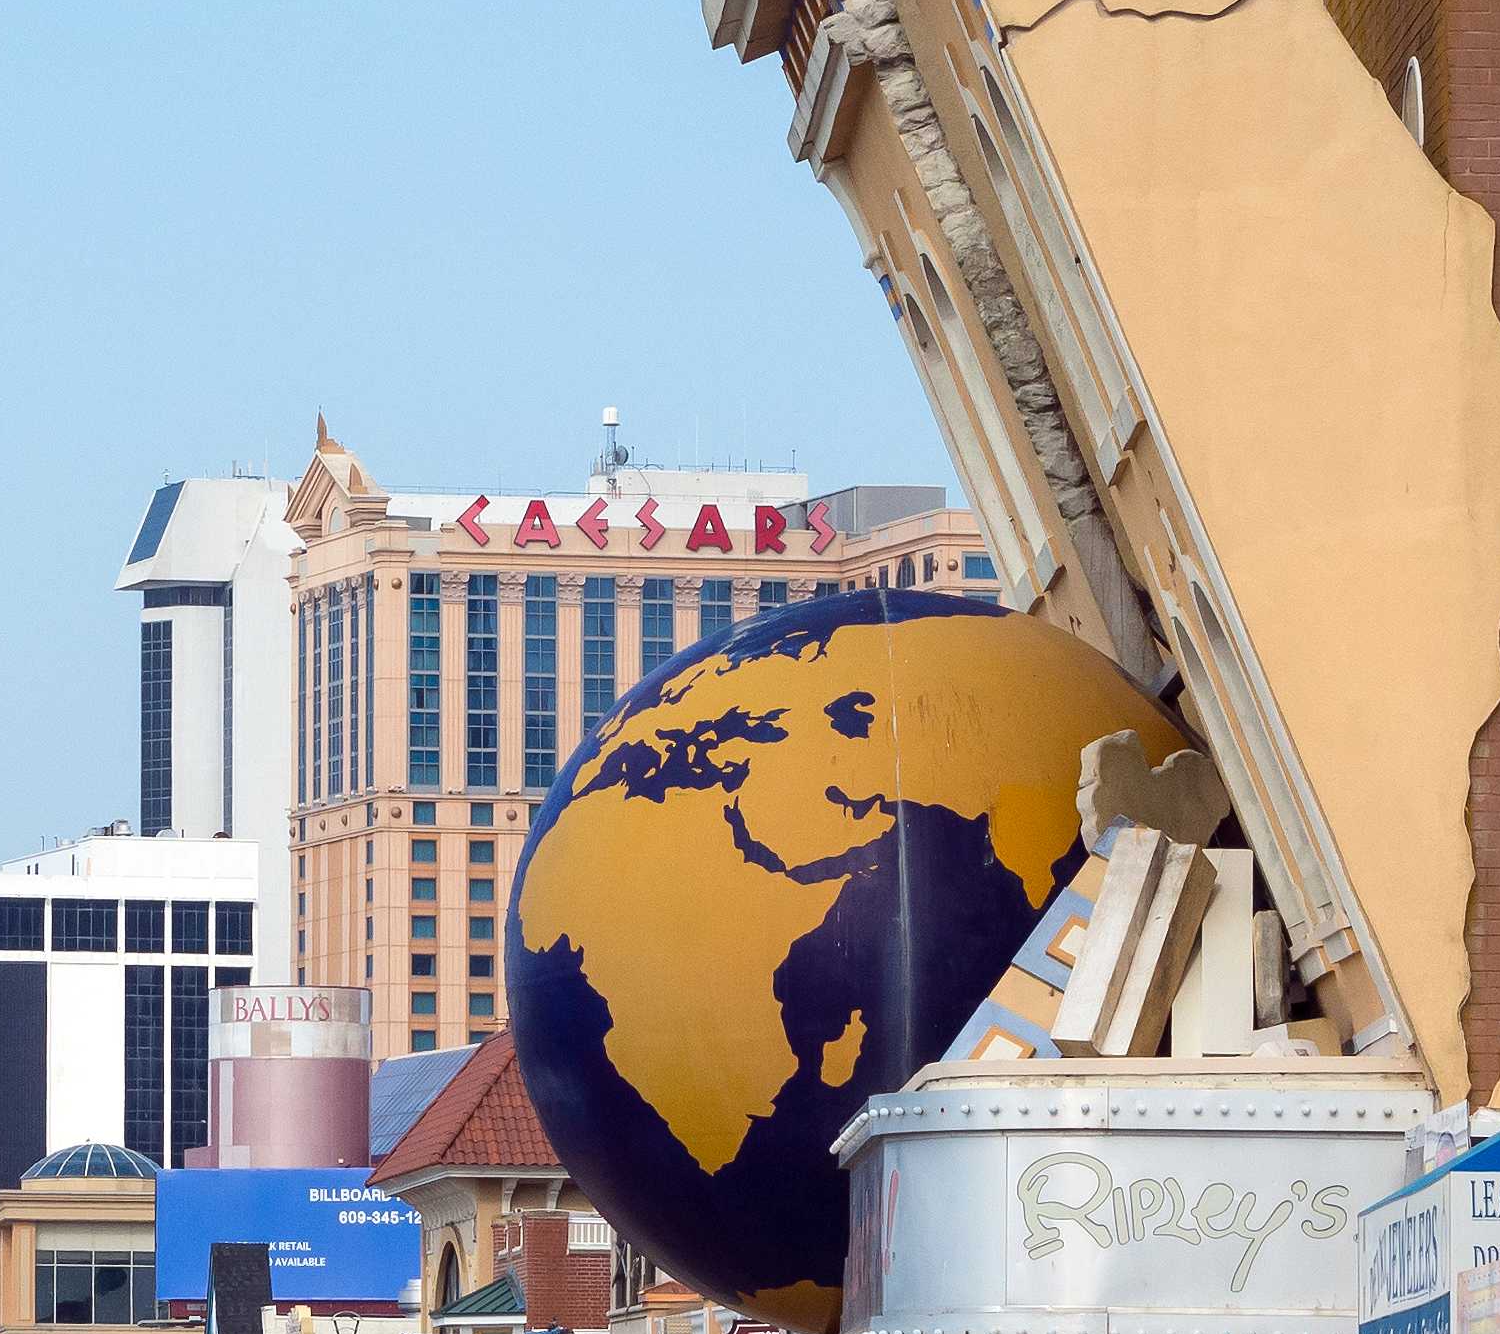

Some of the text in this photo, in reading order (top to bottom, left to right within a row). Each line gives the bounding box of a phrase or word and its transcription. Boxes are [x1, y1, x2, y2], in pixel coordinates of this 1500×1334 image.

[455, 494, 837, 556] CAESARS
[234, 994, 330, 1022] BALLY'S
[339, 1210, 421, 1224] 609-345-12
[278, 1241, 312, 1251] RETAIL
[275, 1257, 326, 1267] AVAILABLE
